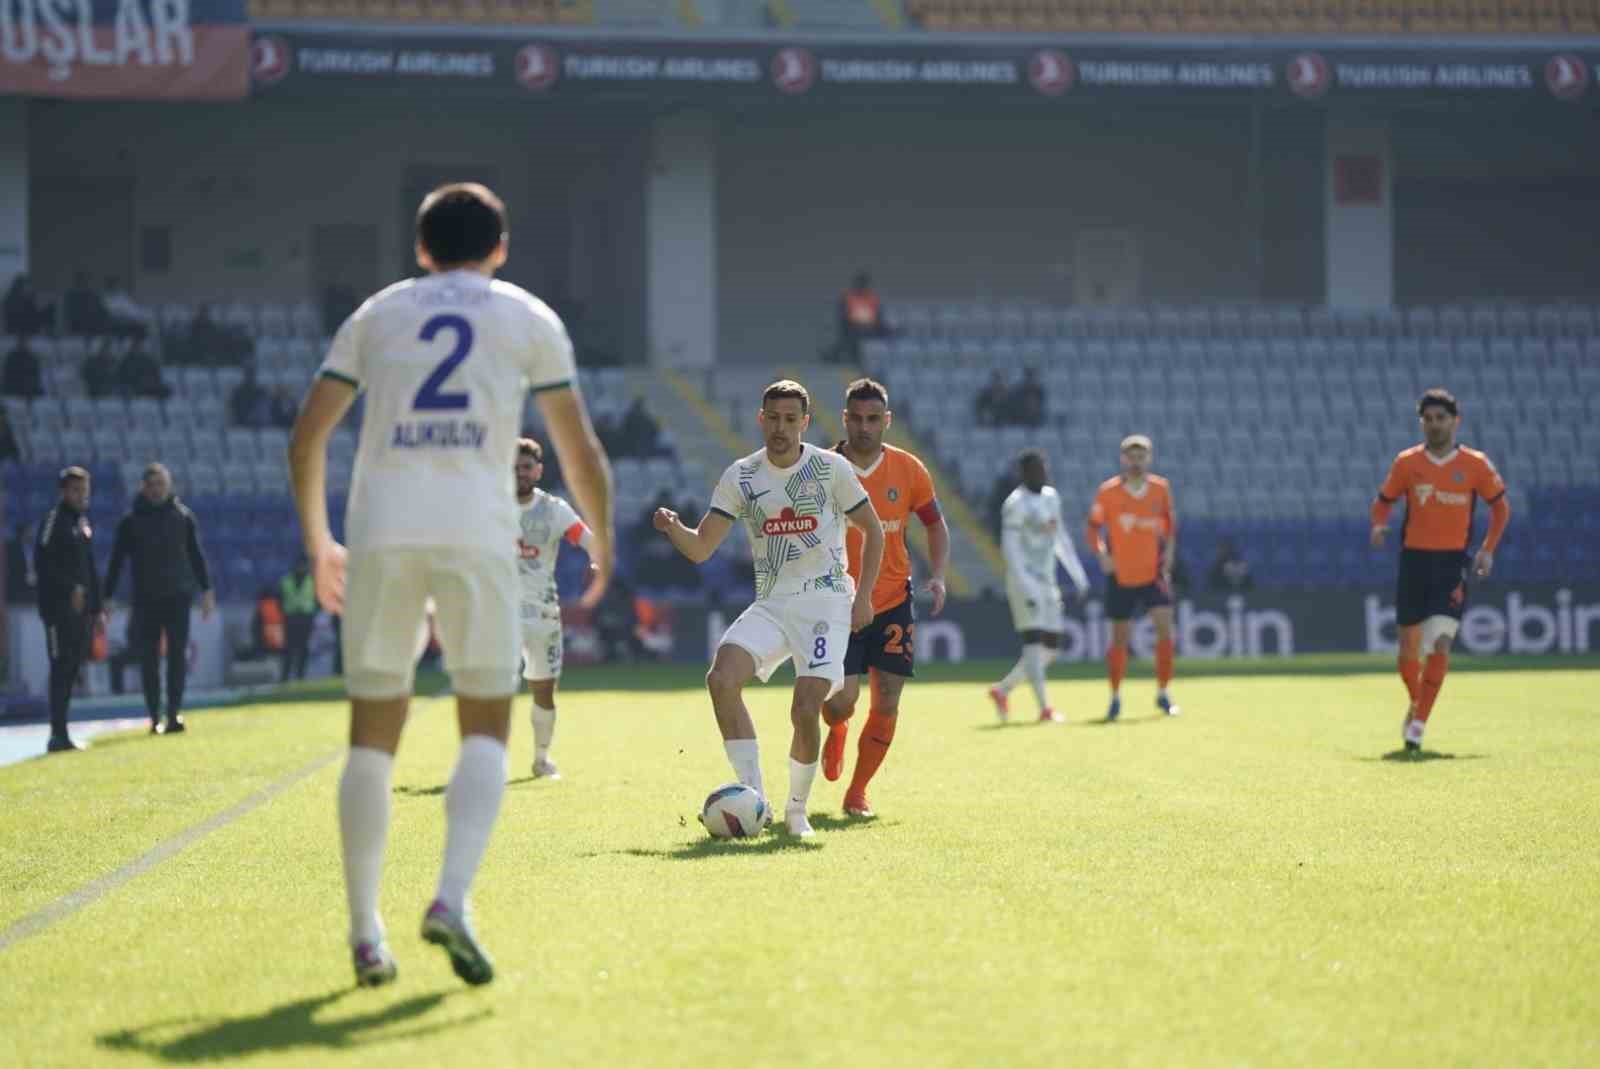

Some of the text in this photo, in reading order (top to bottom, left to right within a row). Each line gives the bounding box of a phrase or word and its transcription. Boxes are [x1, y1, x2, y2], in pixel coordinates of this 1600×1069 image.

[298, 48, 494, 76] TURKISH AIRLINES
[565, 56, 760, 81] TURKISH AIRLINES
[822, 60, 1017, 83] TURKISH AIRLINES
[1079, 62, 1273, 86] TURKISH AIRLINES
[1336, 64, 1533, 88] TURKISH AIRLINES
[413, 313, 474, 411] 2
[1364, 587, 1600, 654] bebin
[813, 636, 827, 659] 8
